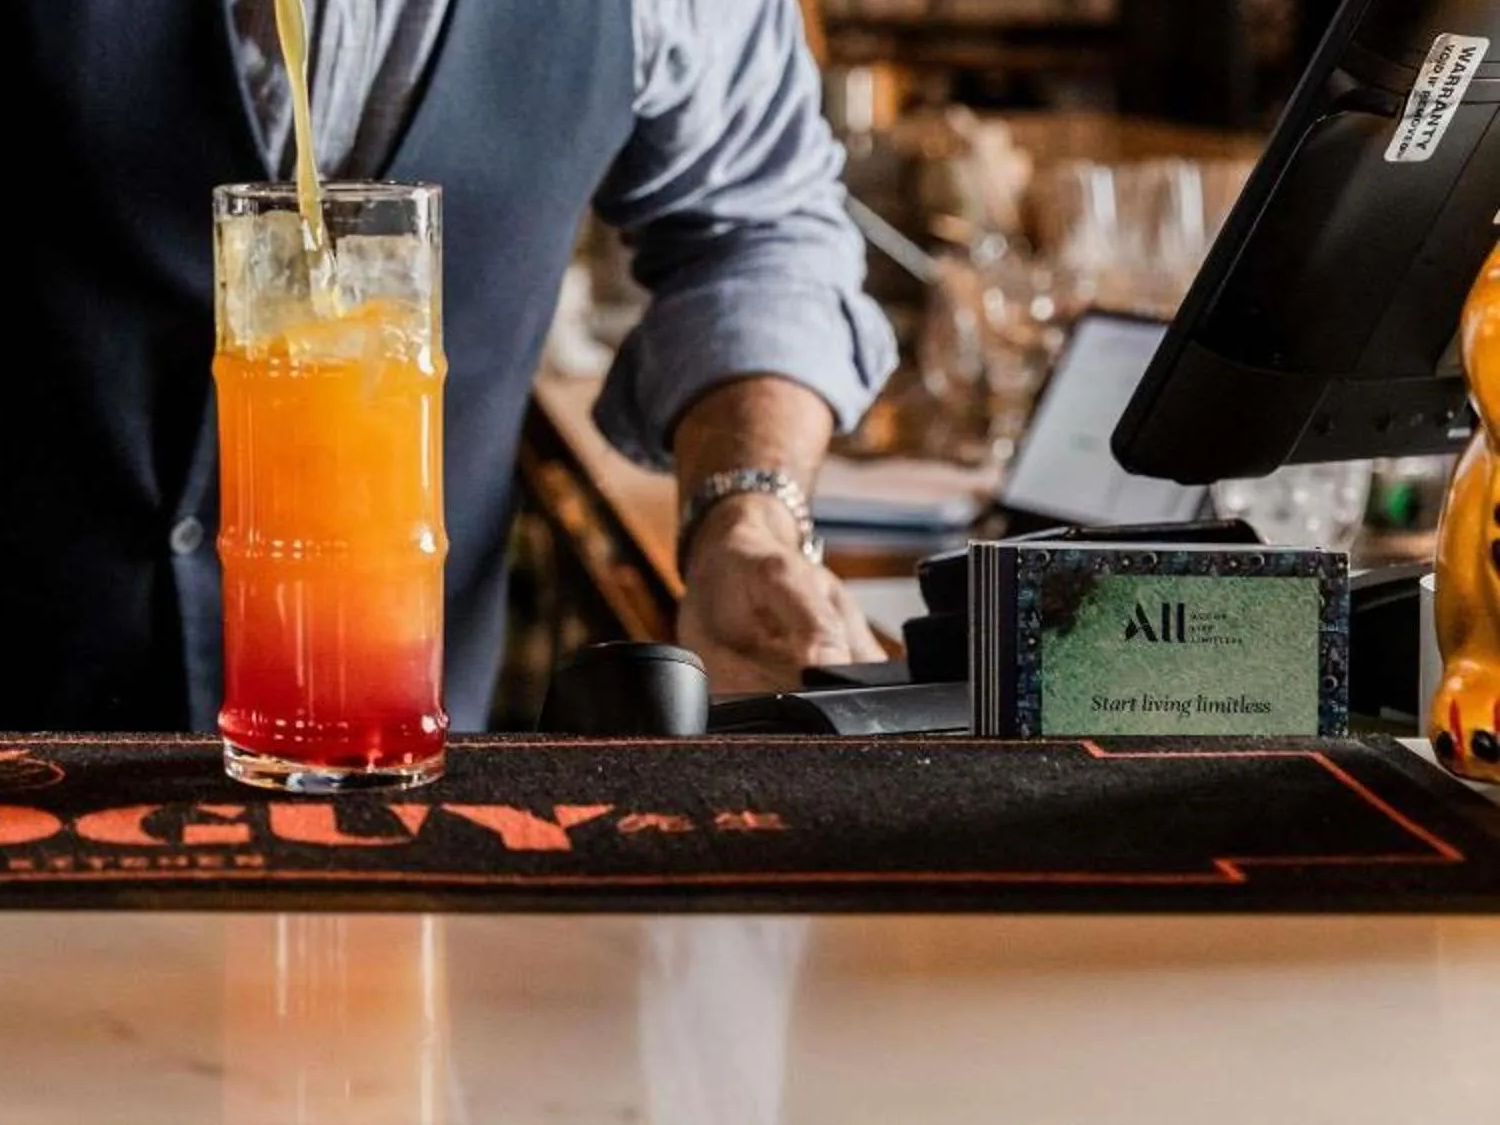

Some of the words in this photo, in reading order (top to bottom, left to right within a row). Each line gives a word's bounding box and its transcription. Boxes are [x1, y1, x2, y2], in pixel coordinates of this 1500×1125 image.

[1433, 44, 1455, 74] VOID
[1415, 46, 1477, 151] WARRANTY
[1124, 601, 1186, 644] All
[1091, 694, 1137, 713] Start
[1142, 693, 1192, 717] living
[1195, 694, 1273, 714] limitless
[8, 853, 264, 870] KITCHEN
